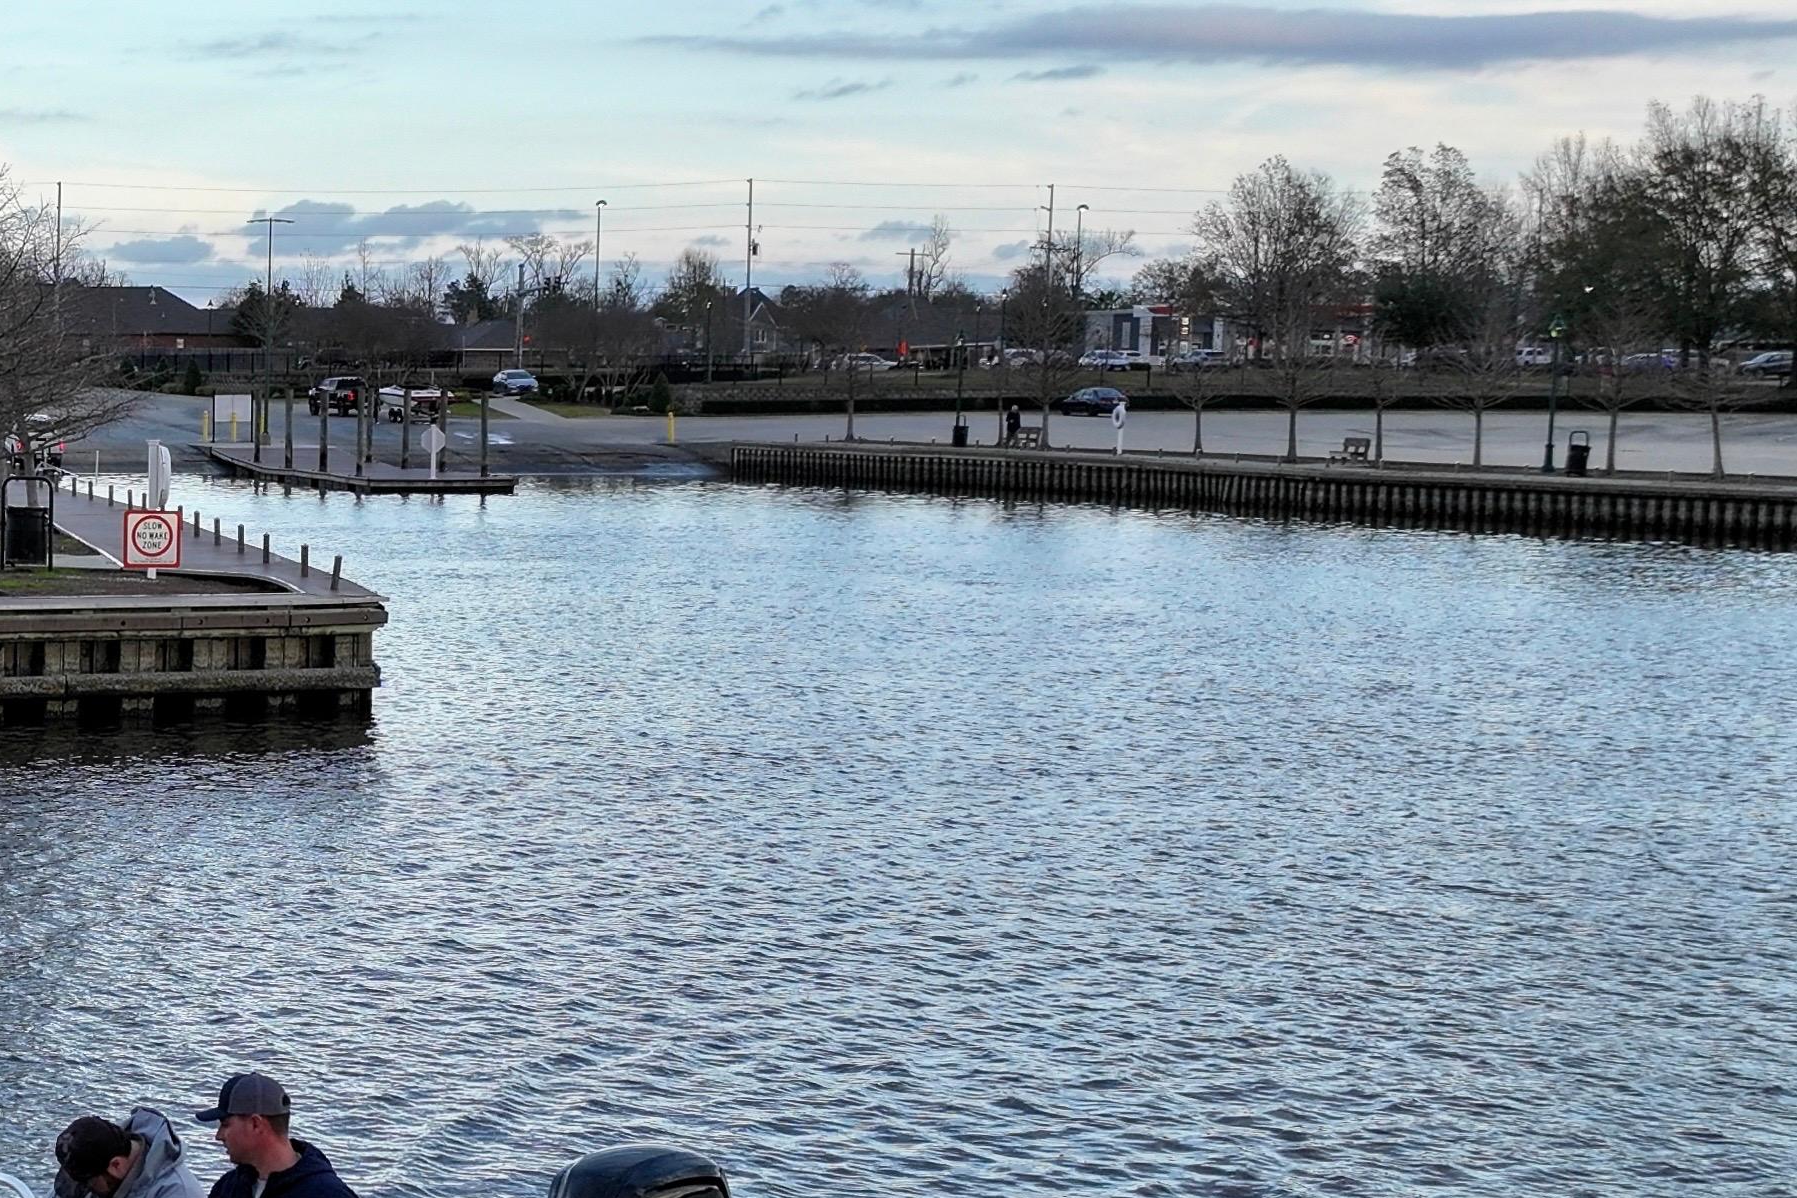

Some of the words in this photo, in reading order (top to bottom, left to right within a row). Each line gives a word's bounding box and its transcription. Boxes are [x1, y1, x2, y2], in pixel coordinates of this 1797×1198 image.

[143, 522, 163, 530] SLOW
[137, 532, 147, 540] NO
[149, 532, 168, 540] WAKE
[142, 541, 162, 550] ZONE
